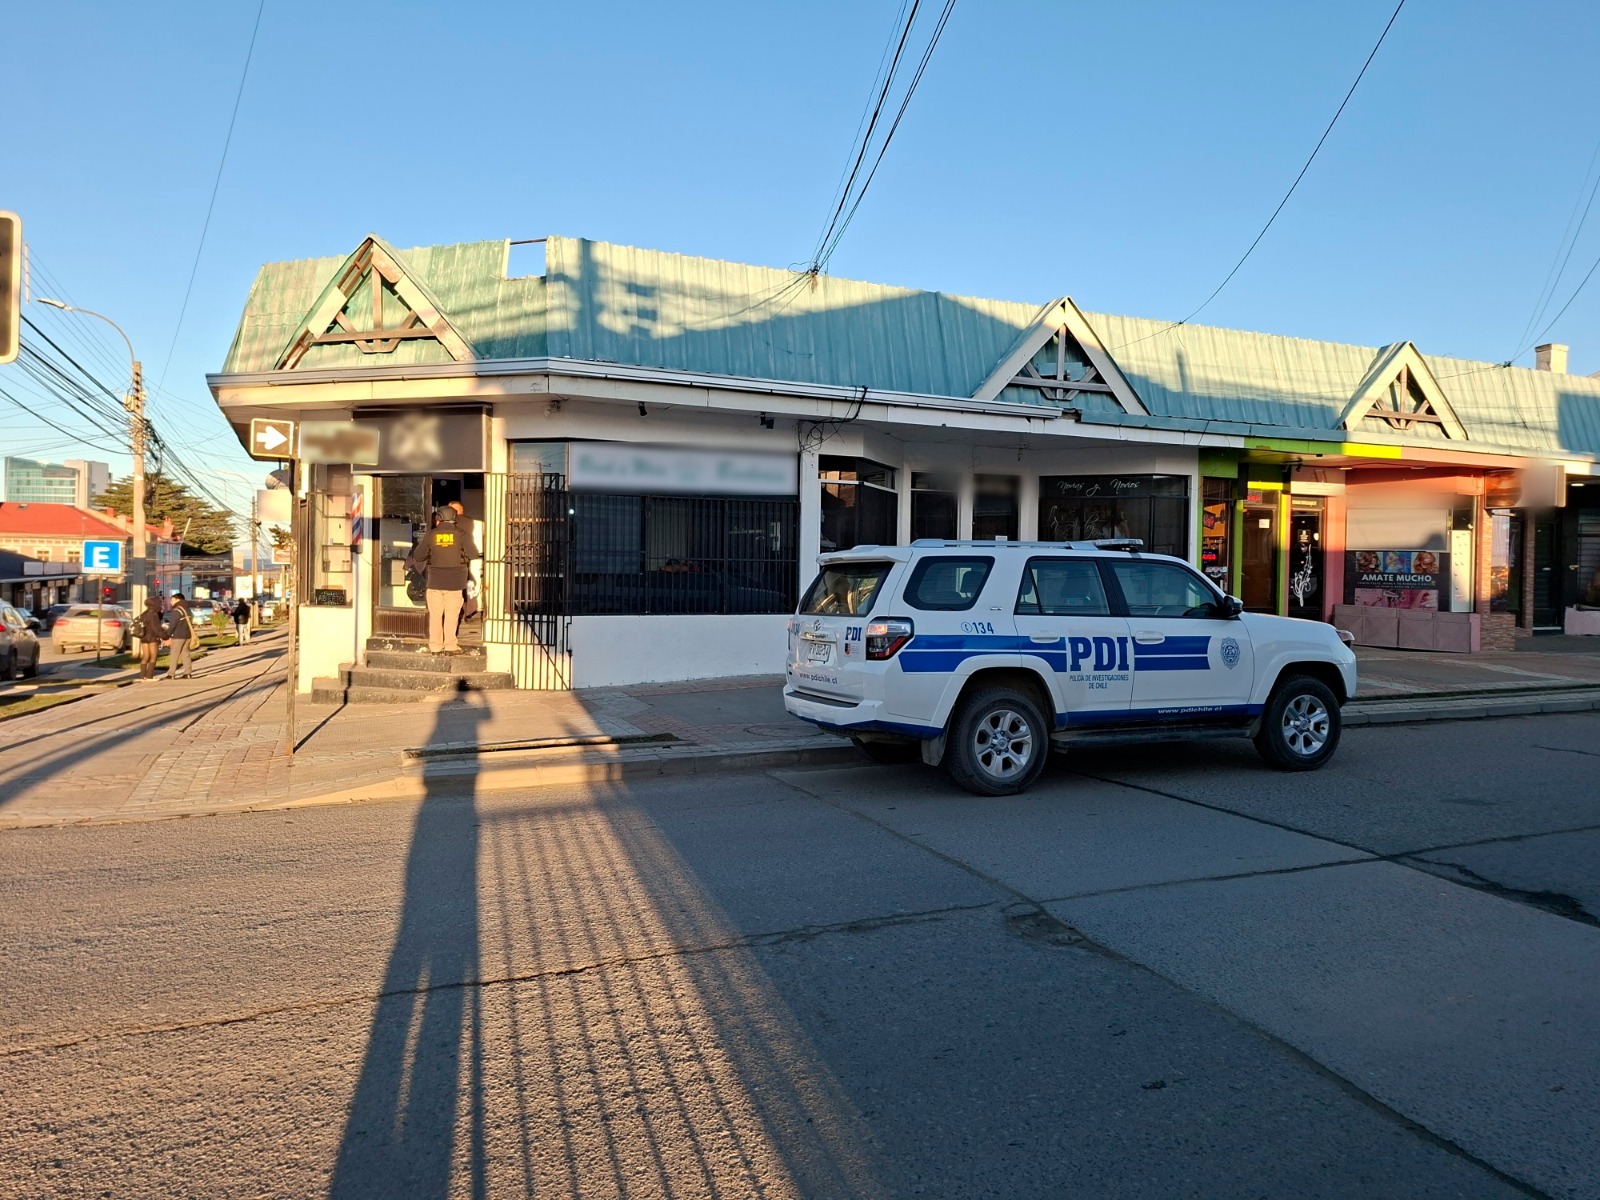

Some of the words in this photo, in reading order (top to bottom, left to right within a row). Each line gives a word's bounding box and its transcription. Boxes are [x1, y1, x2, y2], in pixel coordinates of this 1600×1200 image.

[436, 534, 454, 542] PDI
[93, 546, 110, 567] E
[1361, 574, 1394, 582] AMATE
[1396, 574, 1432, 583] MUCHO
[972, 621, 994, 635] 134
[845, 626, 862, 642] PDI
[1068, 637, 1129, 671] PDI
[1085, 674, 1091, 682] DE
[1092, 674, 1129, 682] INVESTIGACIONES
[1088, 682, 1094, 690] DE
[1095, 682, 1108, 690] CHILE
